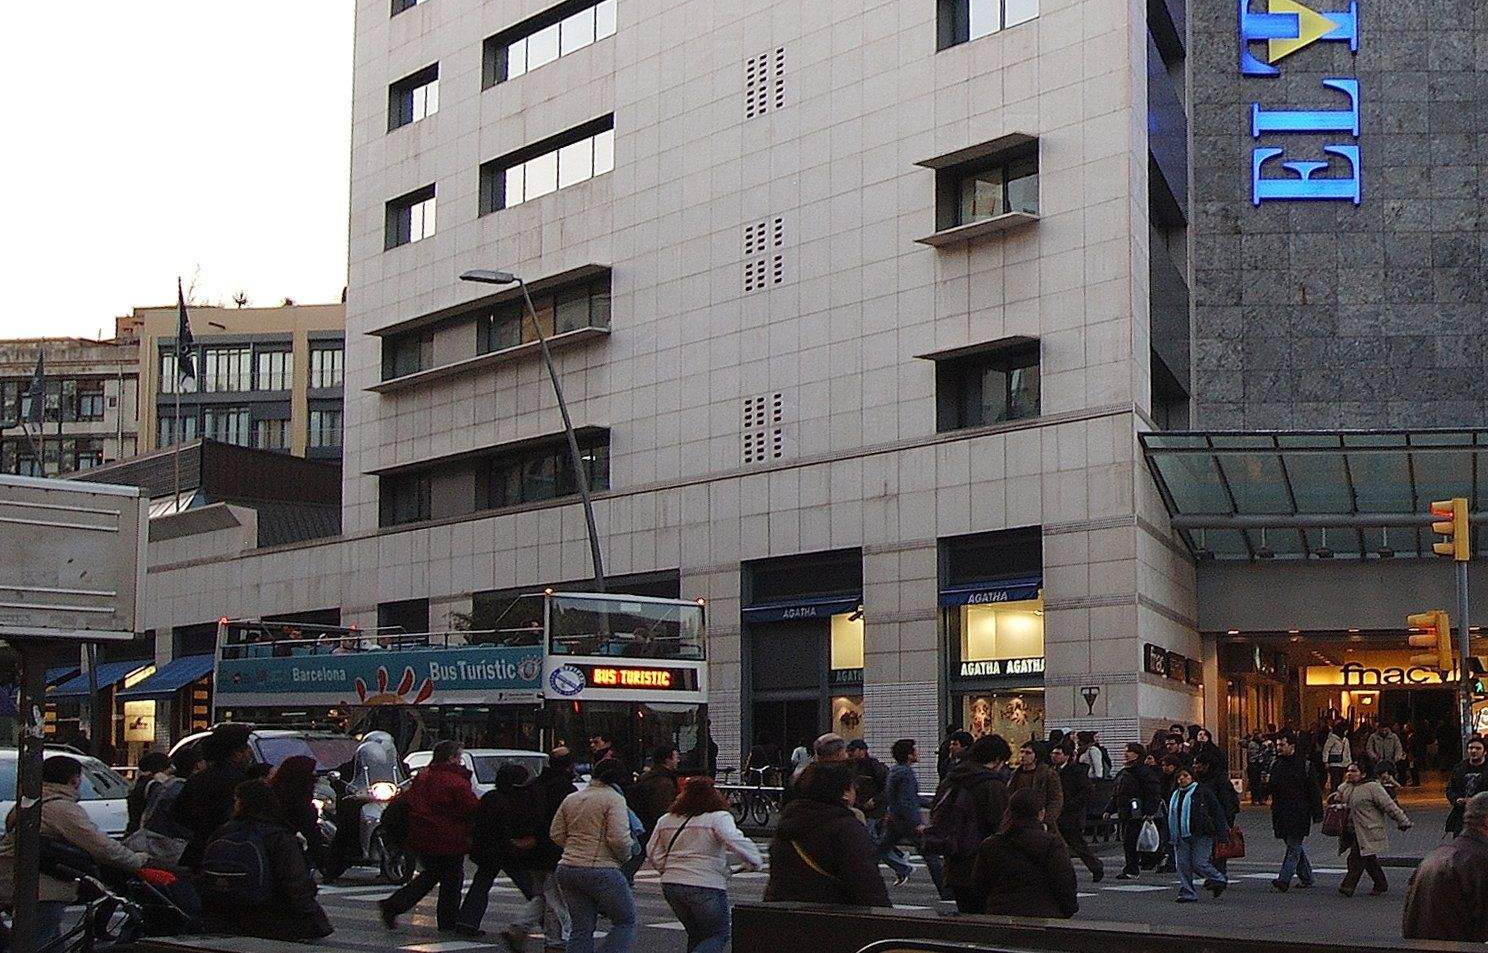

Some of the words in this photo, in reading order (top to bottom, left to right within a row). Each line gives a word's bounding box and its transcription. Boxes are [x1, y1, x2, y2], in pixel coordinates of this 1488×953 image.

[1250, 76, 1362, 205] EL
[967, 590, 1009, 604] AGATHA
[782, 606, 817, 619] AGATHA
[292, 667, 347, 682] Barcelona
[429, 661, 457, 683] Bus
[593, 668, 616, 684] BUS
[620, 669, 670, 686] TURISTIC
[960, 661, 1001, 677] AGATHA
[1341, 661, 1431, 684] fnac
